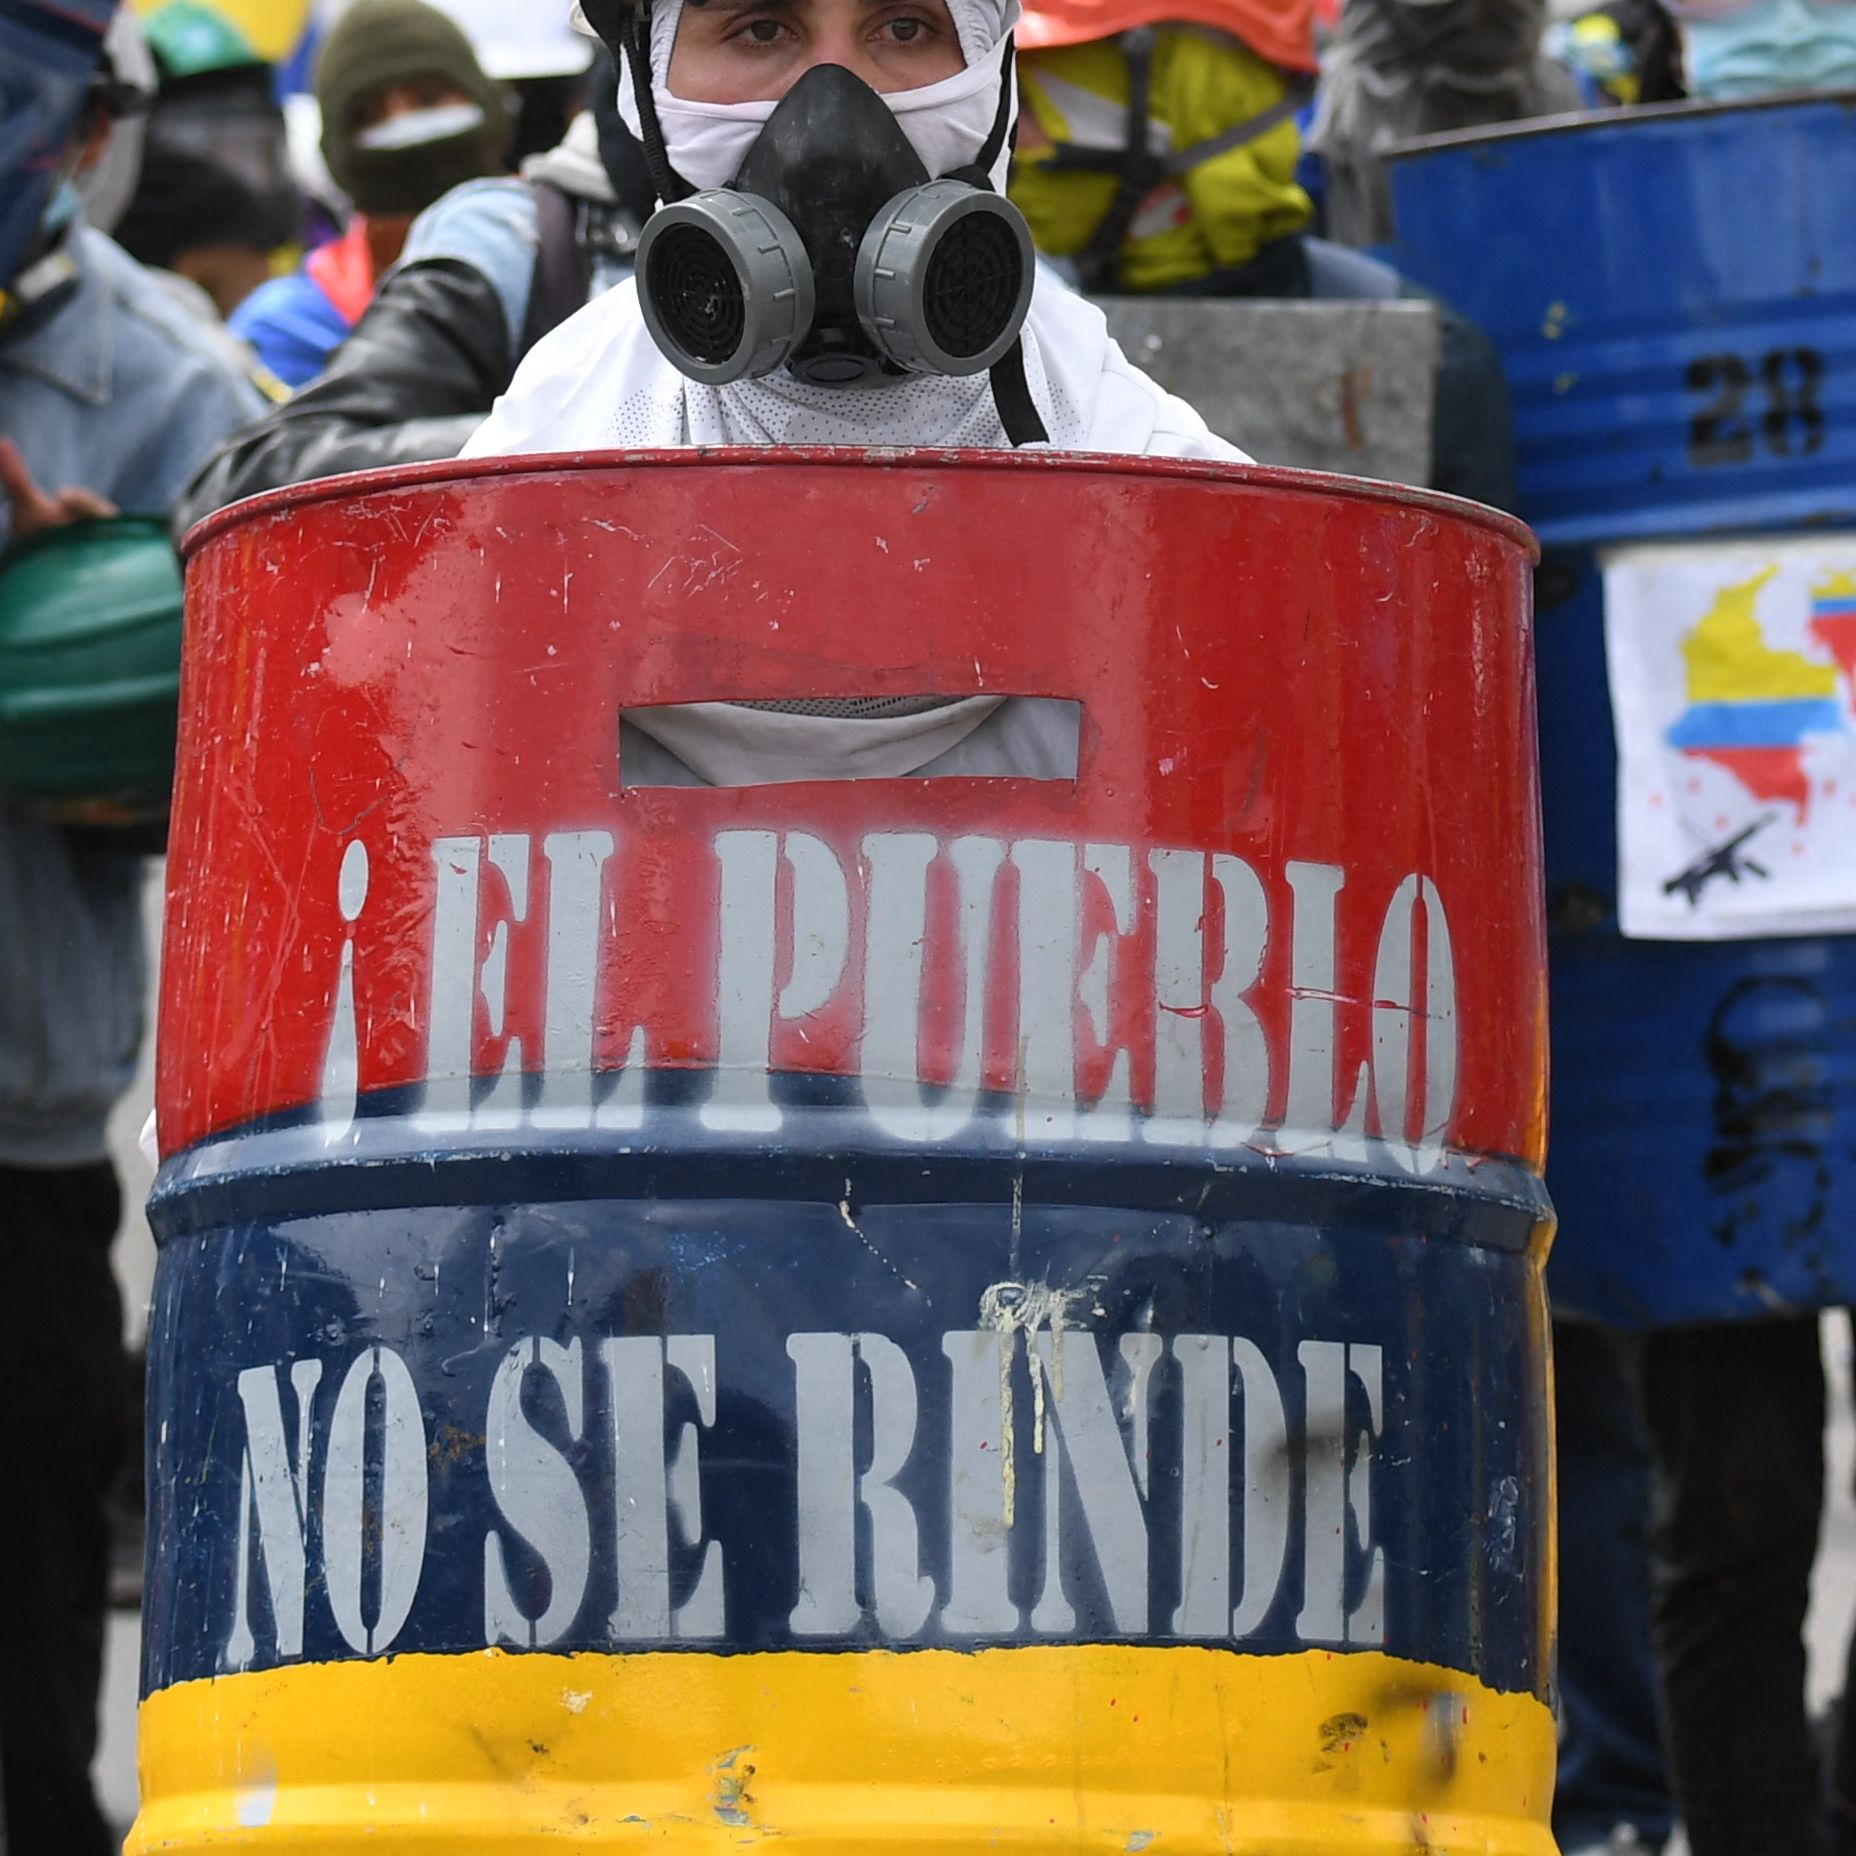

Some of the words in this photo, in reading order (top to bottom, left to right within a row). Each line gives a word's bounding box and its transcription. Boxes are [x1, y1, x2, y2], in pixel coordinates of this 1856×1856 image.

[1685, 346, 1826, 467] 28
[697, 828, 1463, 1173] PUEBLO
[223, 1346, 429, 1665] NO
[482, 1332, 727, 1647] SE
[787, 1330, 1386, 1645] RINDE
